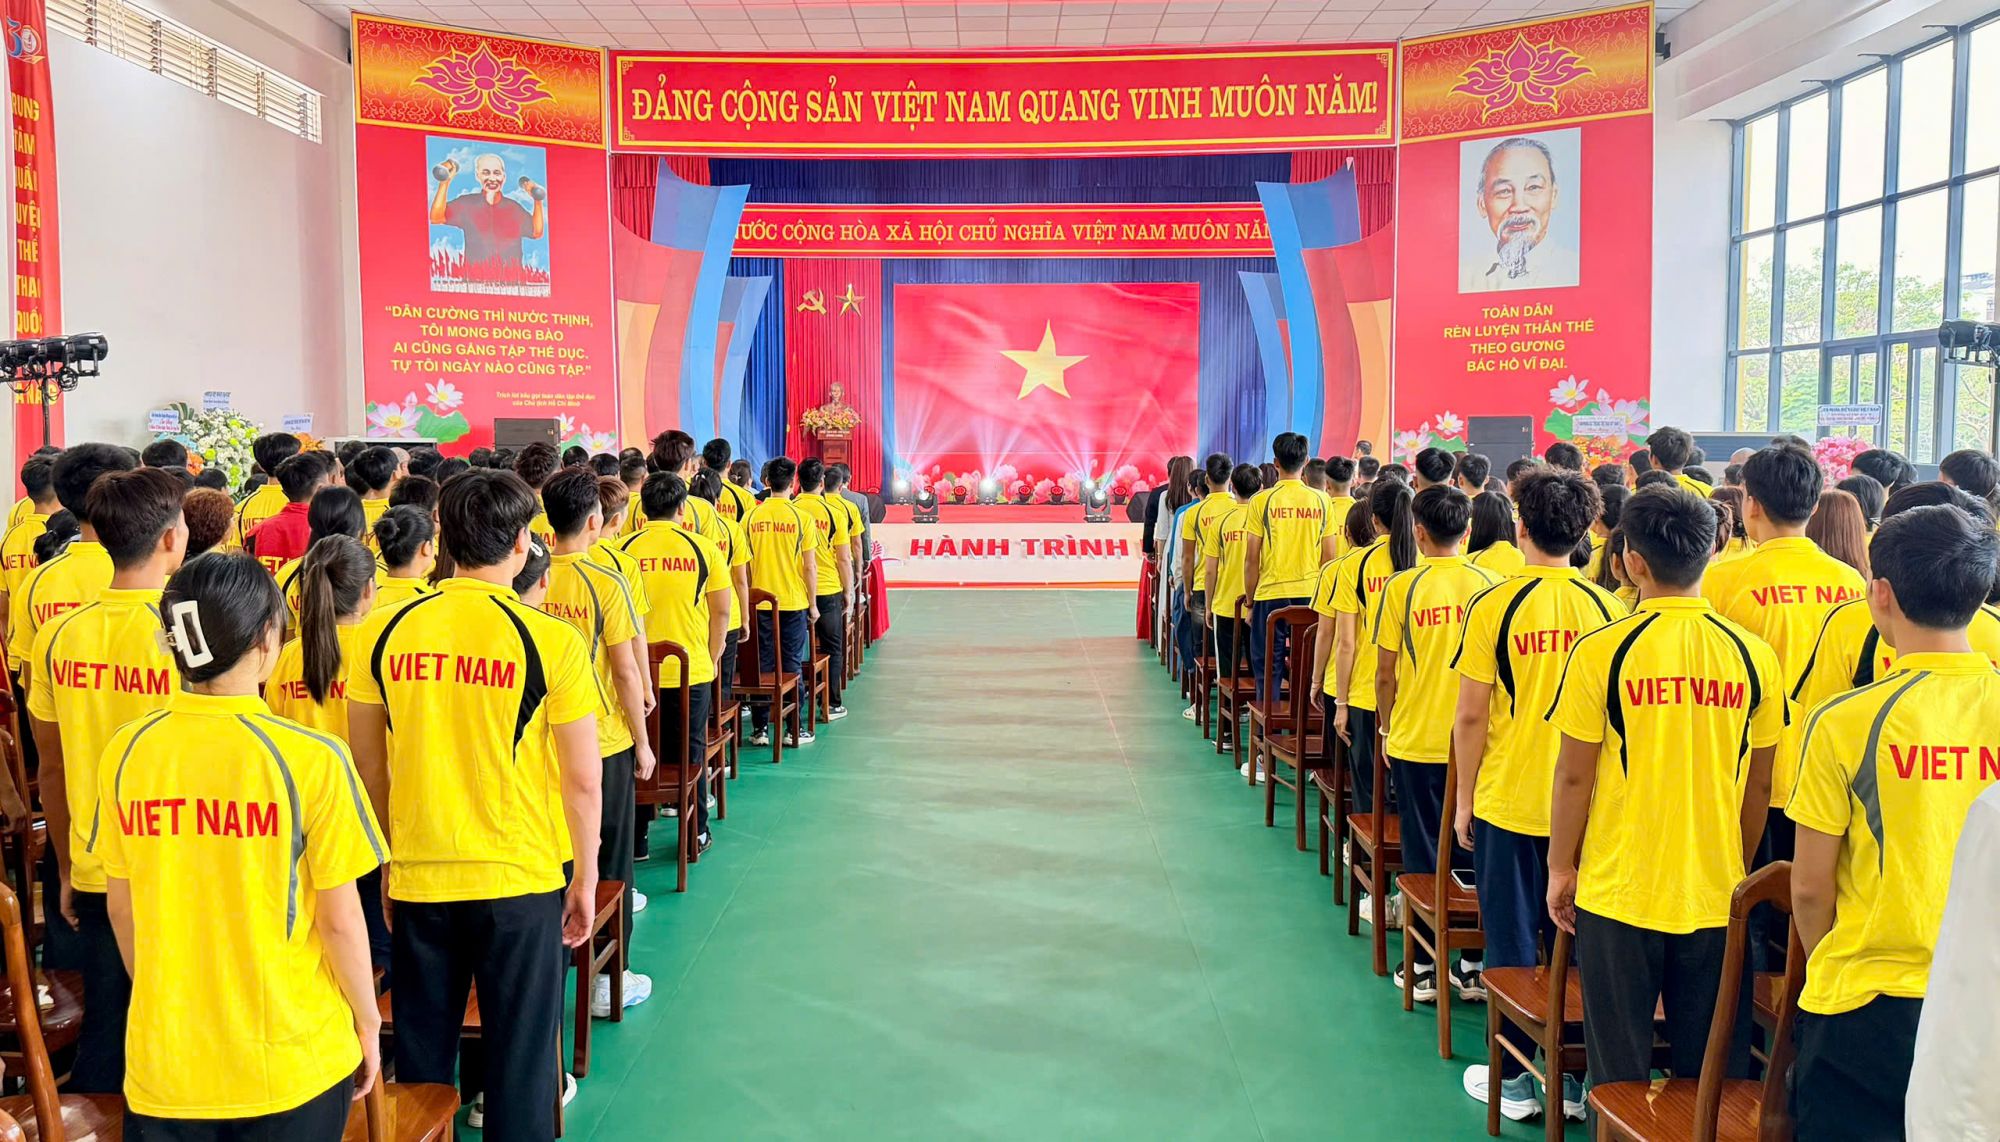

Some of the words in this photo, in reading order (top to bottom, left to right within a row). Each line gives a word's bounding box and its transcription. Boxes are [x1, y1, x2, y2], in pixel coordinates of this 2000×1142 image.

[12, 92, 40, 121] RUNG
[632, 74, 714, 121] ĐẢNG
[720, 80, 799, 130] CỘNG
[806, 76, 864, 122] SẢN
[872, 80, 938, 131] VIỆT
[945, 90, 1011, 122] NAM
[1018, 88, 1120, 124] QUANG
[1128, 86, 1202, 120] VINH
[1210, 74, 1297, 118] MUÔN
[1305, 73, 1378, 116] NĂM!
[782, 220, 834, 245] CỘNG
[840, 220, 880, 241] HÒA
[886, 220, 914, 241] XÃ
[919, 220, 954, 245] HỘI
[959, 218, 998, 241] CHỦ
[1004, 220, 1066, 240] NGHĨA
[1072, 220, 1116, 244] VIỆT
[1122, 224, 1166, 240] NAM
[1171, 218, 1230, 240] MUÔN
[16, 274, 41, 298] THA
[1524, 302, 1554, 317] DÂN
[16, 306, 43, 335] QUỐ
[420, 322, 443, 336] TÔI
[448, 326, 489, 338] MONG
[1475, 322, 1520, 338] LUYỆN
[1524, 320, 1562, 334] THÂN
[394, 342, 408, 353] AI
[1470, 342, 1507, 354] THEO
[1510, 340, 1565, 353] GƯƠNG
[414, 358, 438, 372] TÔI
[1466, 358, 1495, 372] BÁC
[1270, 508, 1294, 519] VIET
[1296, 508, 1322, 519] NAM
[750, 522, 772, 533] VIET
[773, 522, 796, 534] NAM
[1224, 530, 1244, 542] VIET
[910, 534, 1009, 556] HÀNH
[1021, 534, 1129, 556] TRÌNH
[640, 558, 658, 572] ET
[662, 558, 696, 572] NAM
[1751, 586, 1808, 607] VIET
[1413, 606, 1452, 627] VIET
[1514, 630, 1560, 656] VIET
[53, 662, 108, 690] VIET
[114, 665, 170, 696] NAM
[389, 652, 448, 682] VIET
[455, 655, 516, 689] NAM
[1626, 676, 1686, 706] VIET
[1690, 678, 1744, 709] NAM
[1888, 744, 1969, 780] VIET
[117, 798, 186, 838] VIET
[196, 799, 279, 838] NAM
